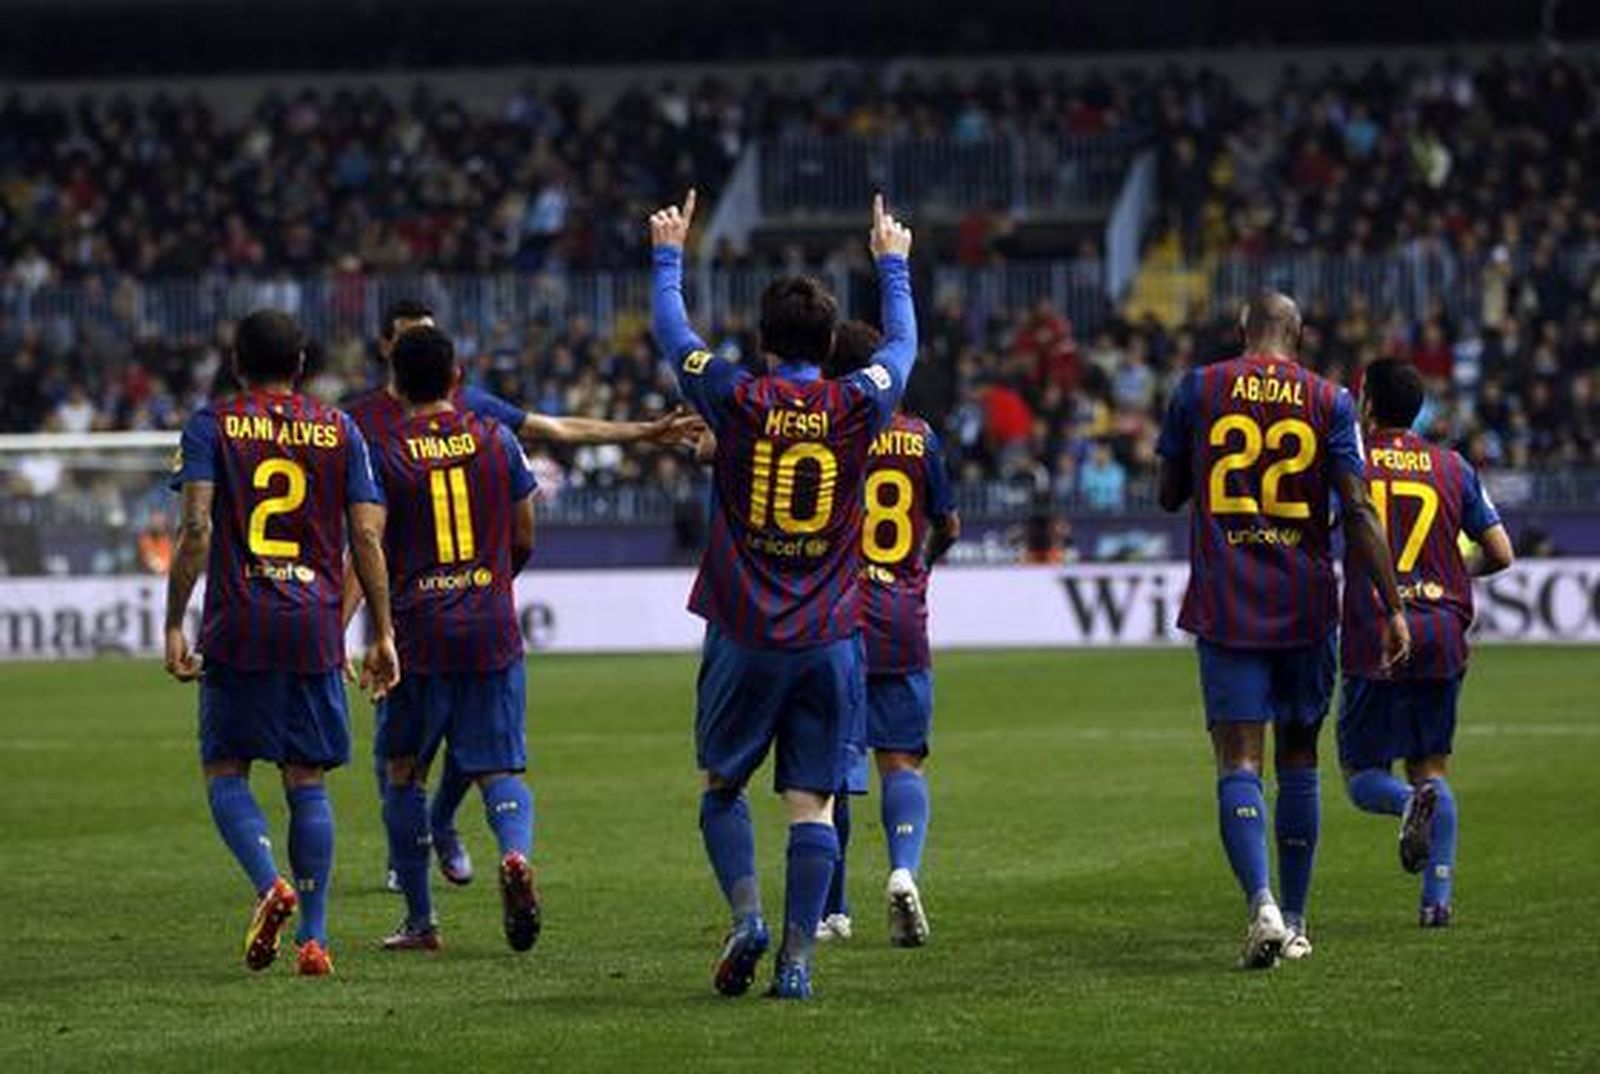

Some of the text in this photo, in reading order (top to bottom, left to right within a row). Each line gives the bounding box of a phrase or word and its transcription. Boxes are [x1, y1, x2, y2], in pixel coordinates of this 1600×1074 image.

[1231, 375, 1303, 406] ABIDAL
[225, 415, 338, 448] DANI ALVES
[407, 432, 476, 461] THIAGO
[764, 408, 829, 438] MESSI
[868, 430, 925, 457] ANTOS
[1208, 413, 1317, 519] 22
[1370, 447, 1432, 473] PEDRO
[249, 457, 307, 558] 2
[749, 439, 838, 534] 10
[429, 466, 475, 565] 11
[862, 468, 914, 564] 8
[1370, 480, 1439, 573] 17
[419, 568, 473, 591] unicef
[0, 587, 203, 658] magi
